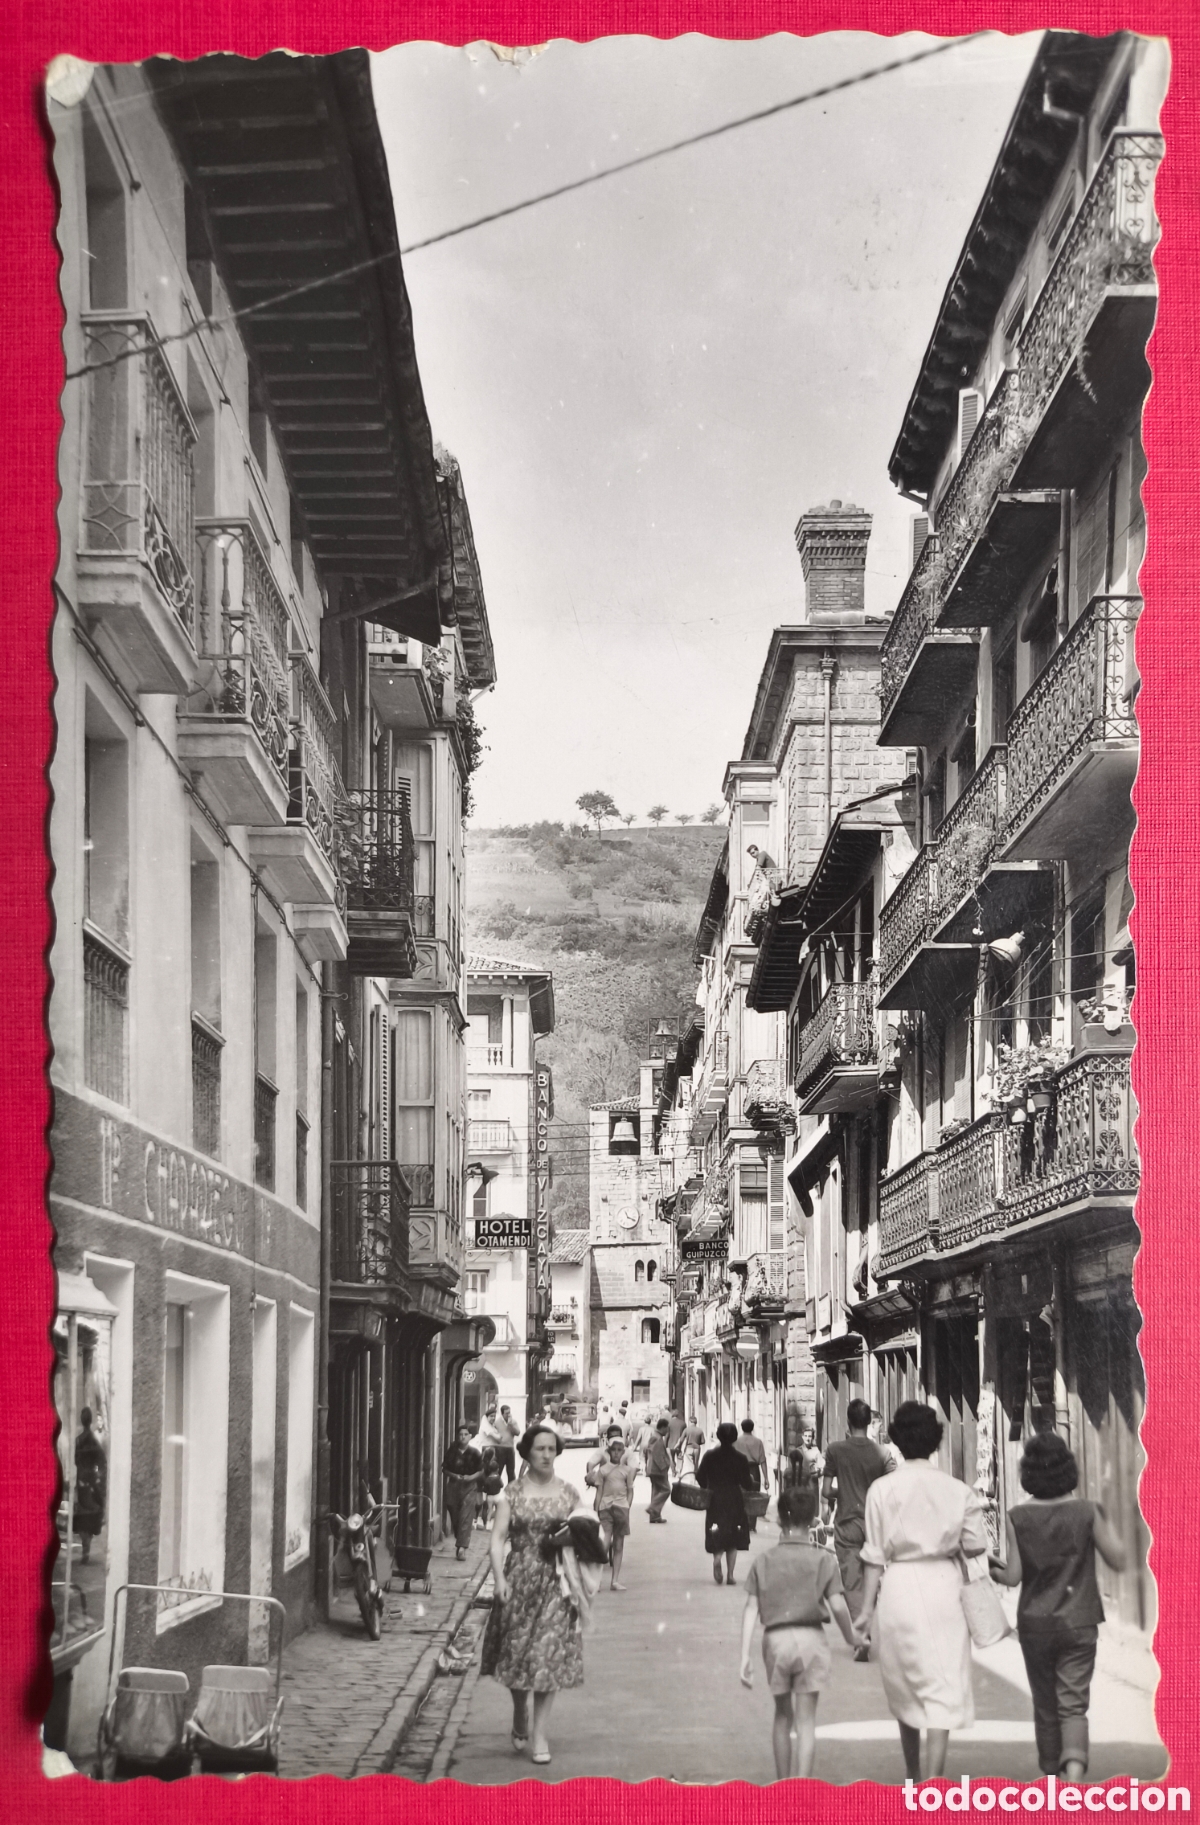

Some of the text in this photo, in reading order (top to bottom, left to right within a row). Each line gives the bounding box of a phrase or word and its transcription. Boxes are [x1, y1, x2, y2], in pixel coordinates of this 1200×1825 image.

[537, 1074, 548, 1289] BANCO DE VIZCAYA
[480, 1220, 529, 1234] HOTEL
[477, 1235, 530, 1247] OTAMENDI
[698, 1241, 729, 1250] BANCO
[686, 1250, 729, 1259] GUIPUZCO
